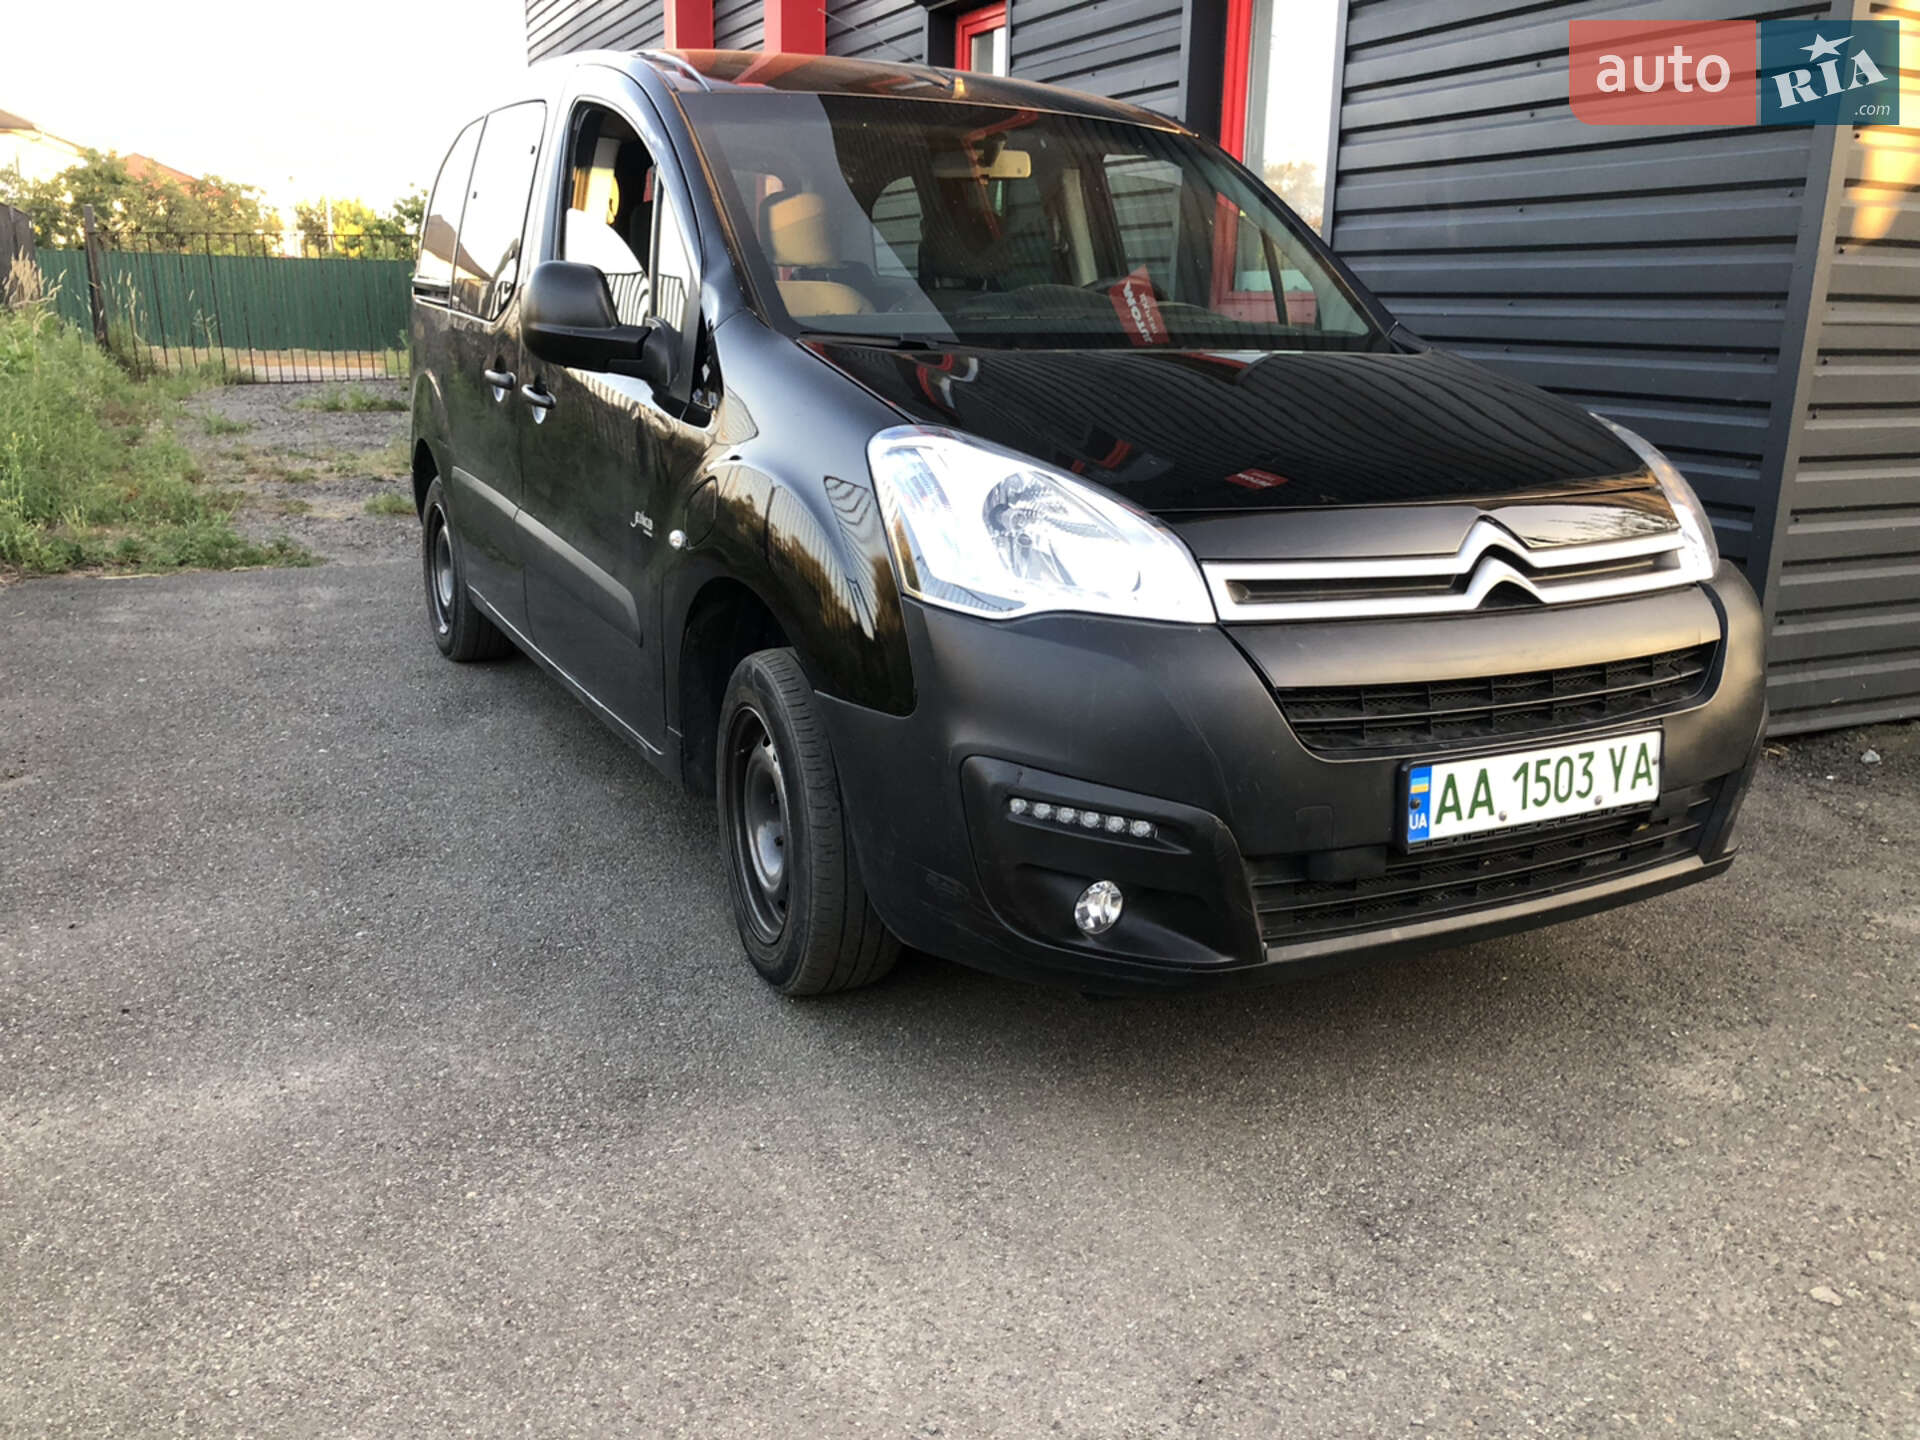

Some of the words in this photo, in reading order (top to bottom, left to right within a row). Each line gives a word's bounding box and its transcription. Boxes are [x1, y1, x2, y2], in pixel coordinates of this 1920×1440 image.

[1435, 767, 1495, 825] AA
[1512, 751, 1595, 810] 1503
[1608, 743, 1653, 793] YA
[1409, 813, 1428, 831] UA
